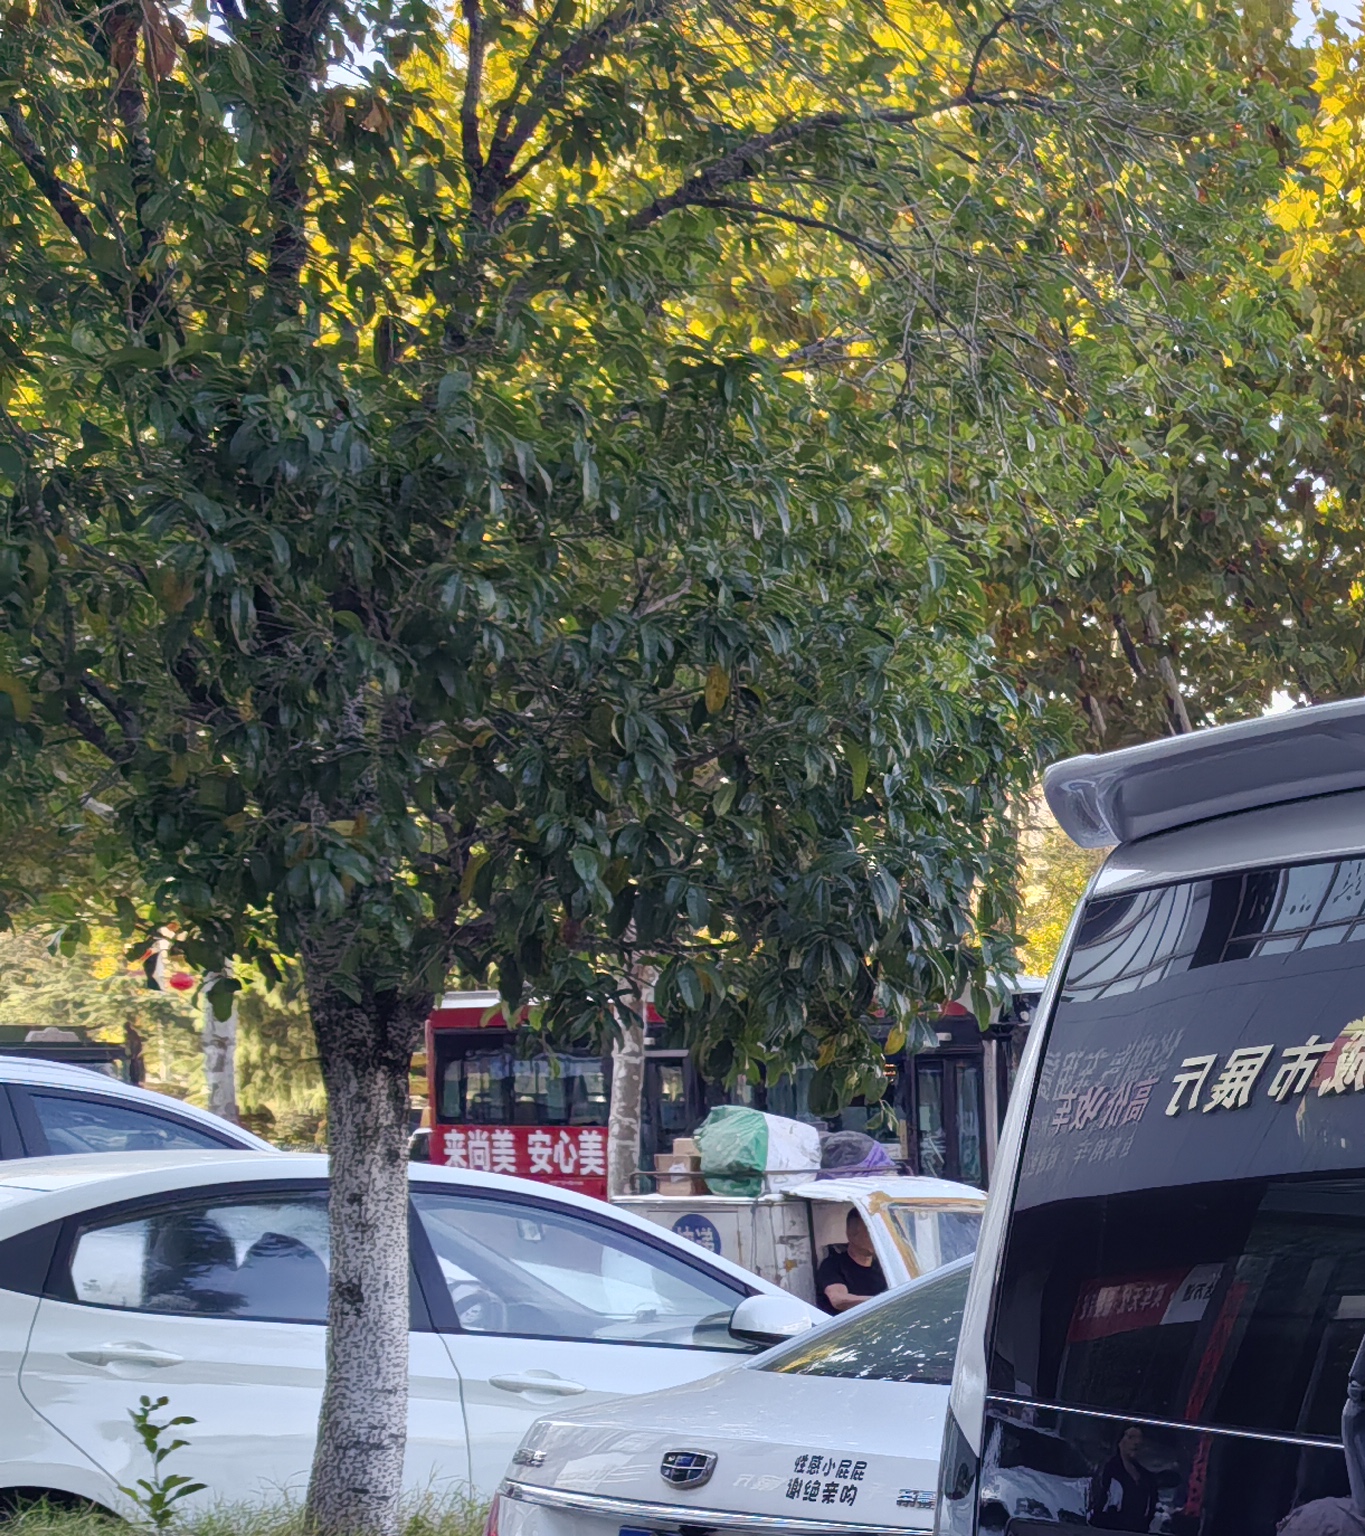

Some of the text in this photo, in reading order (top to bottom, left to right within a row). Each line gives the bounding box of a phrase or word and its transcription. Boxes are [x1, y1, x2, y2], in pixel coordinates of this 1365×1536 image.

[442, 1129, 606, 1176] 来尚美 安心美
[793, 1454, 868, 1481] 性感小屁屁
[785, 1477, 859, 1507] 谢绝亲吻
